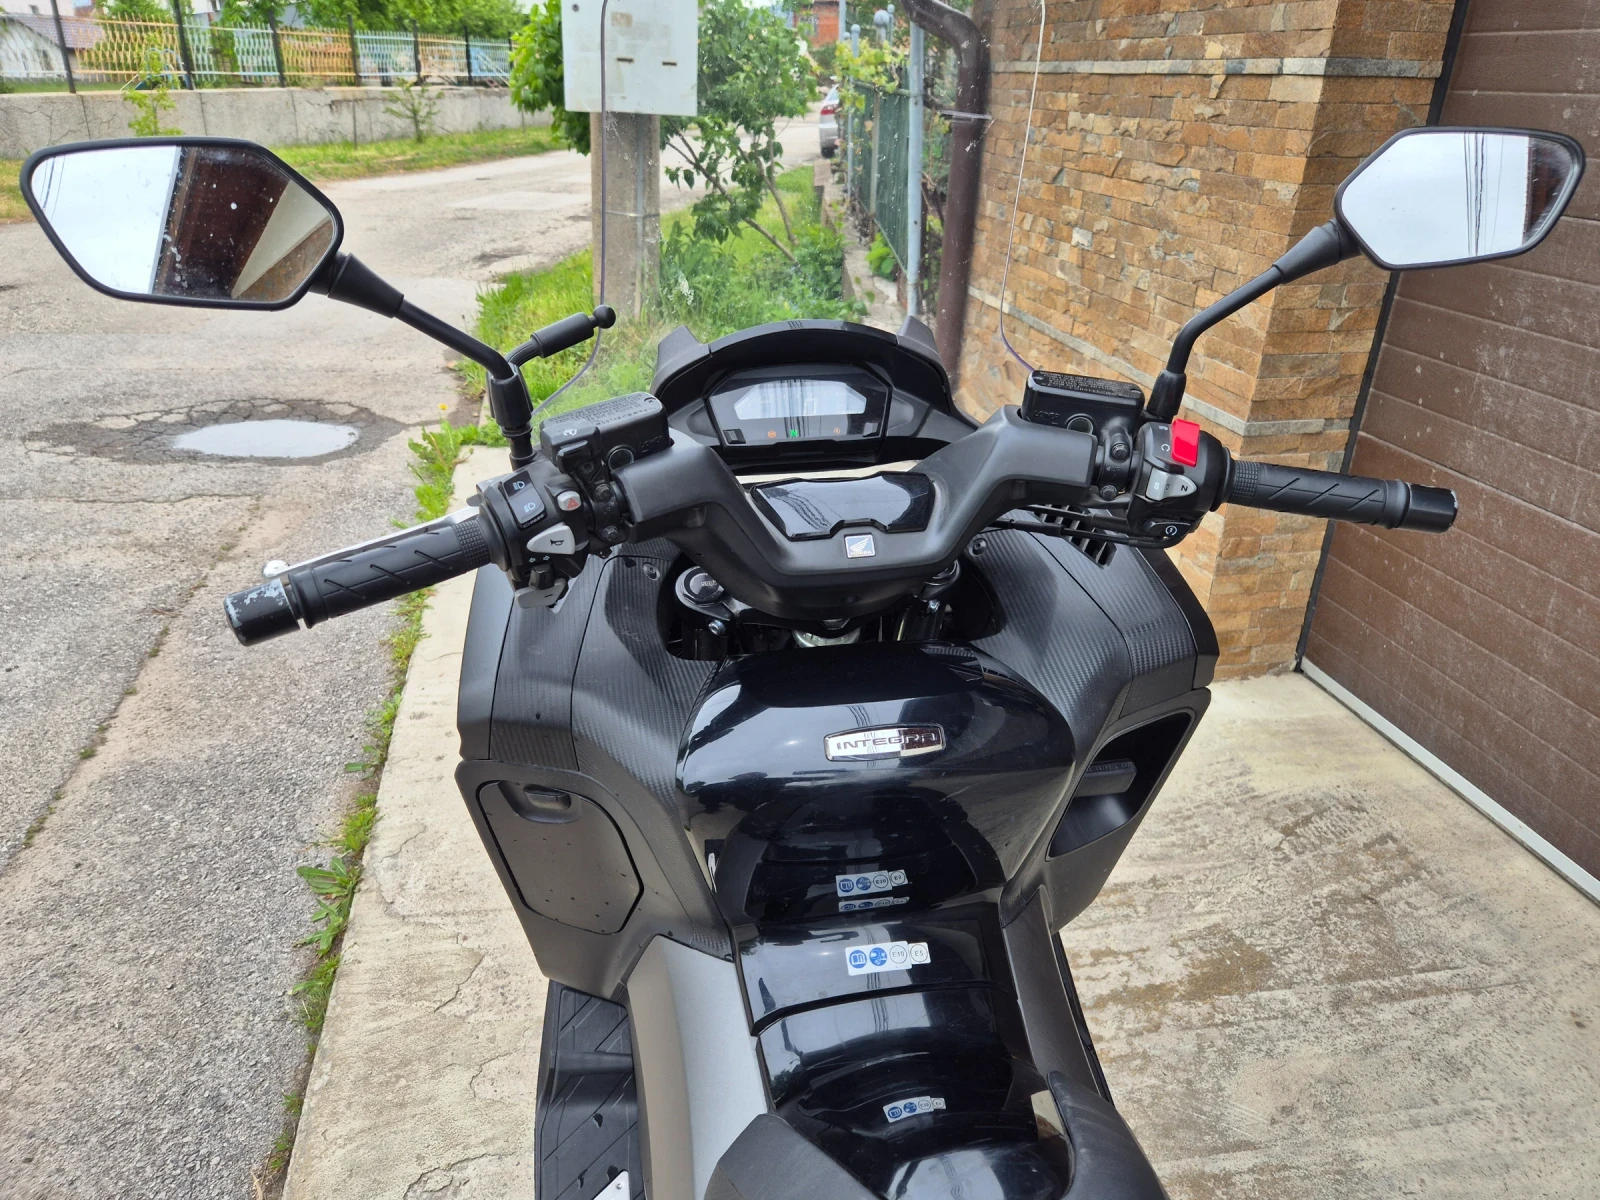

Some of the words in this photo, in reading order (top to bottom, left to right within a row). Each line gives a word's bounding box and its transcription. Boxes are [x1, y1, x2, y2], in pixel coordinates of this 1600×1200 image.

[789, 429, 799, 438] N
[1153, 481, 1160, 490] S
[1180, 484, 1189, 492] N
[836, 733, 936, 750] INTEGRA
[891, 950, 905, 958] E10
[914, 949, 924, 957] E5
